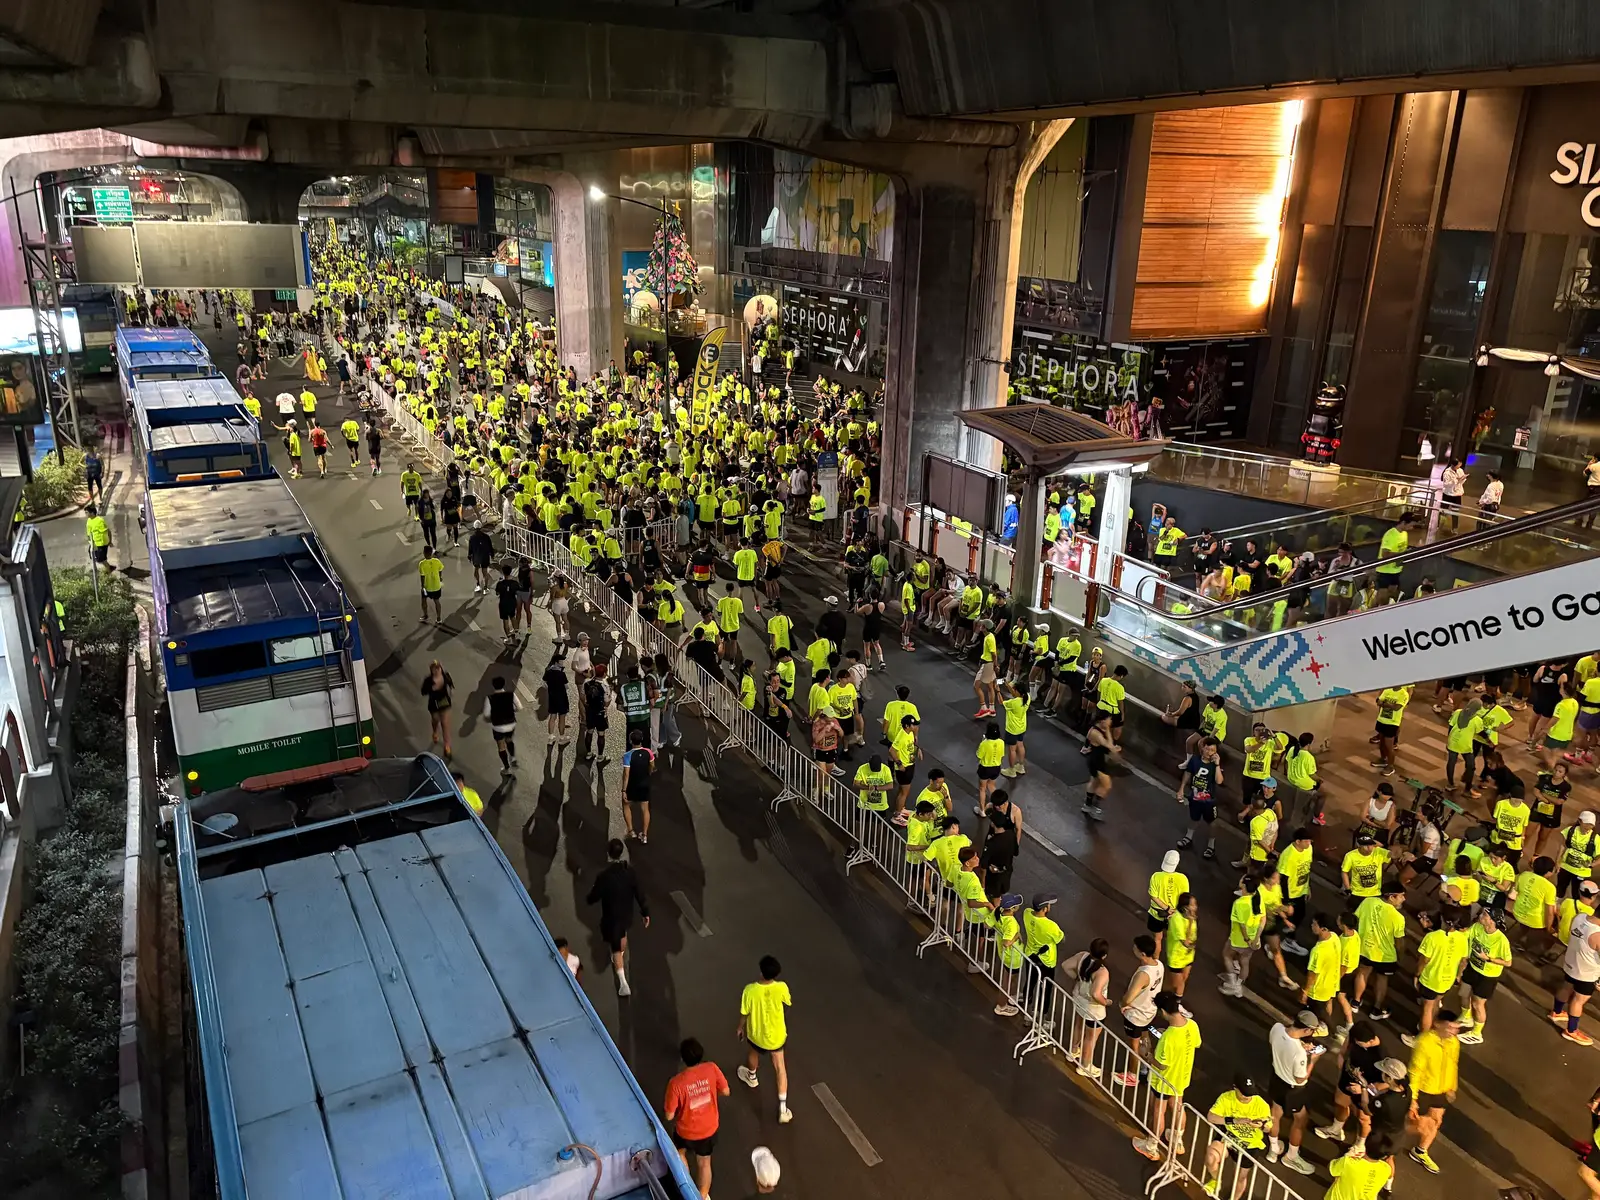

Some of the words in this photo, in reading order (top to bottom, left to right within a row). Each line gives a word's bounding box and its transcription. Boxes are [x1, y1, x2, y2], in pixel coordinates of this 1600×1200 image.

[783, 304, 847, 336] SEPHORA
[692, 363, 715, 426] BLOCK
[1017, 351, 1139, 402] SEPHORA
[1361, 615, 1502, 661] Welcome
[1507, 604, 1545, 630] to
[237, 742, 270, 756] MOBILE
[271, 736, 302, 748] TOILET
